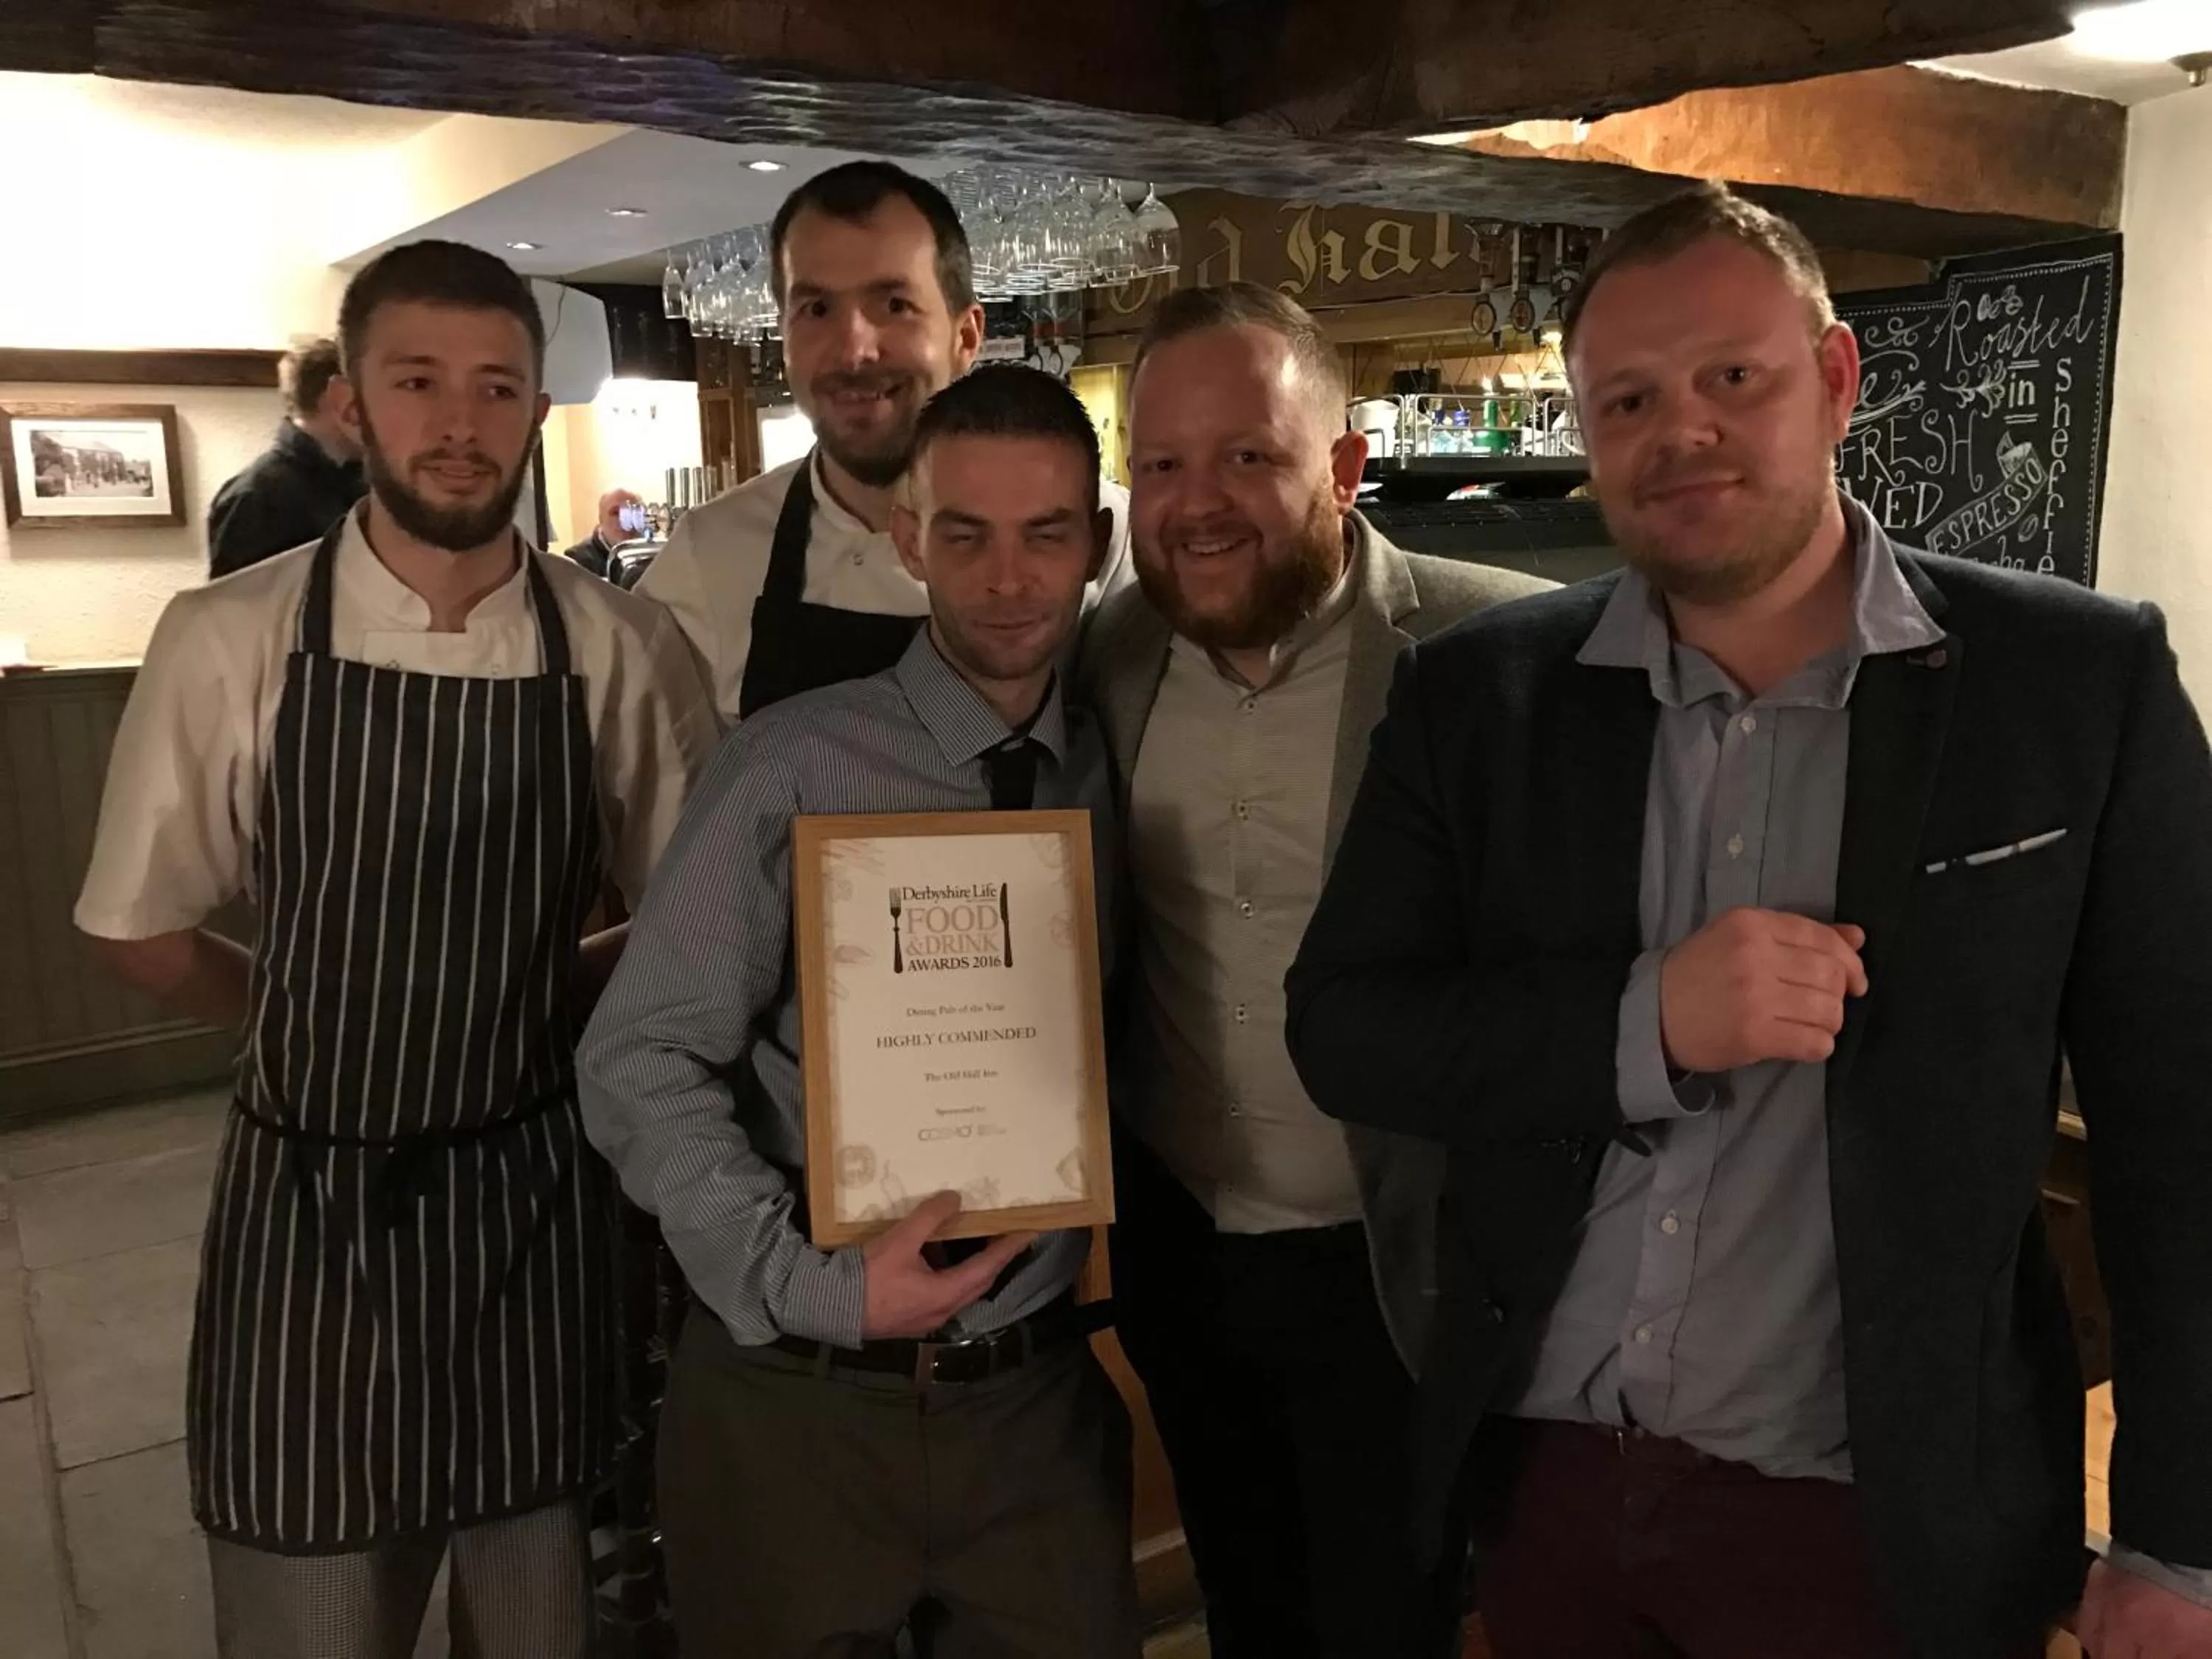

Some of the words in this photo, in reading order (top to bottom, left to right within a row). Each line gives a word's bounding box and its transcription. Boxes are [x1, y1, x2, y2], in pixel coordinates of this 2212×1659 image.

[1277, 199, 1480, 295] Hal
[1929, 275, 2095, 372] Roasted
[2008, 372, 2035, 408] in
[1933, 458, 2042, 554] ESPRESSO
[902, 885, 970, 903] Derbyshire
[973, 883, 998, 897] Life
[905, 905, 999, 934] FOOD
[908, 957, 970, 972] AWARDS
[972, 955, 1002, 968] 2016
[876, 1033, 934, 1048] HIGHLY
[938, 1026, 1037, 1044] COMMENDED
